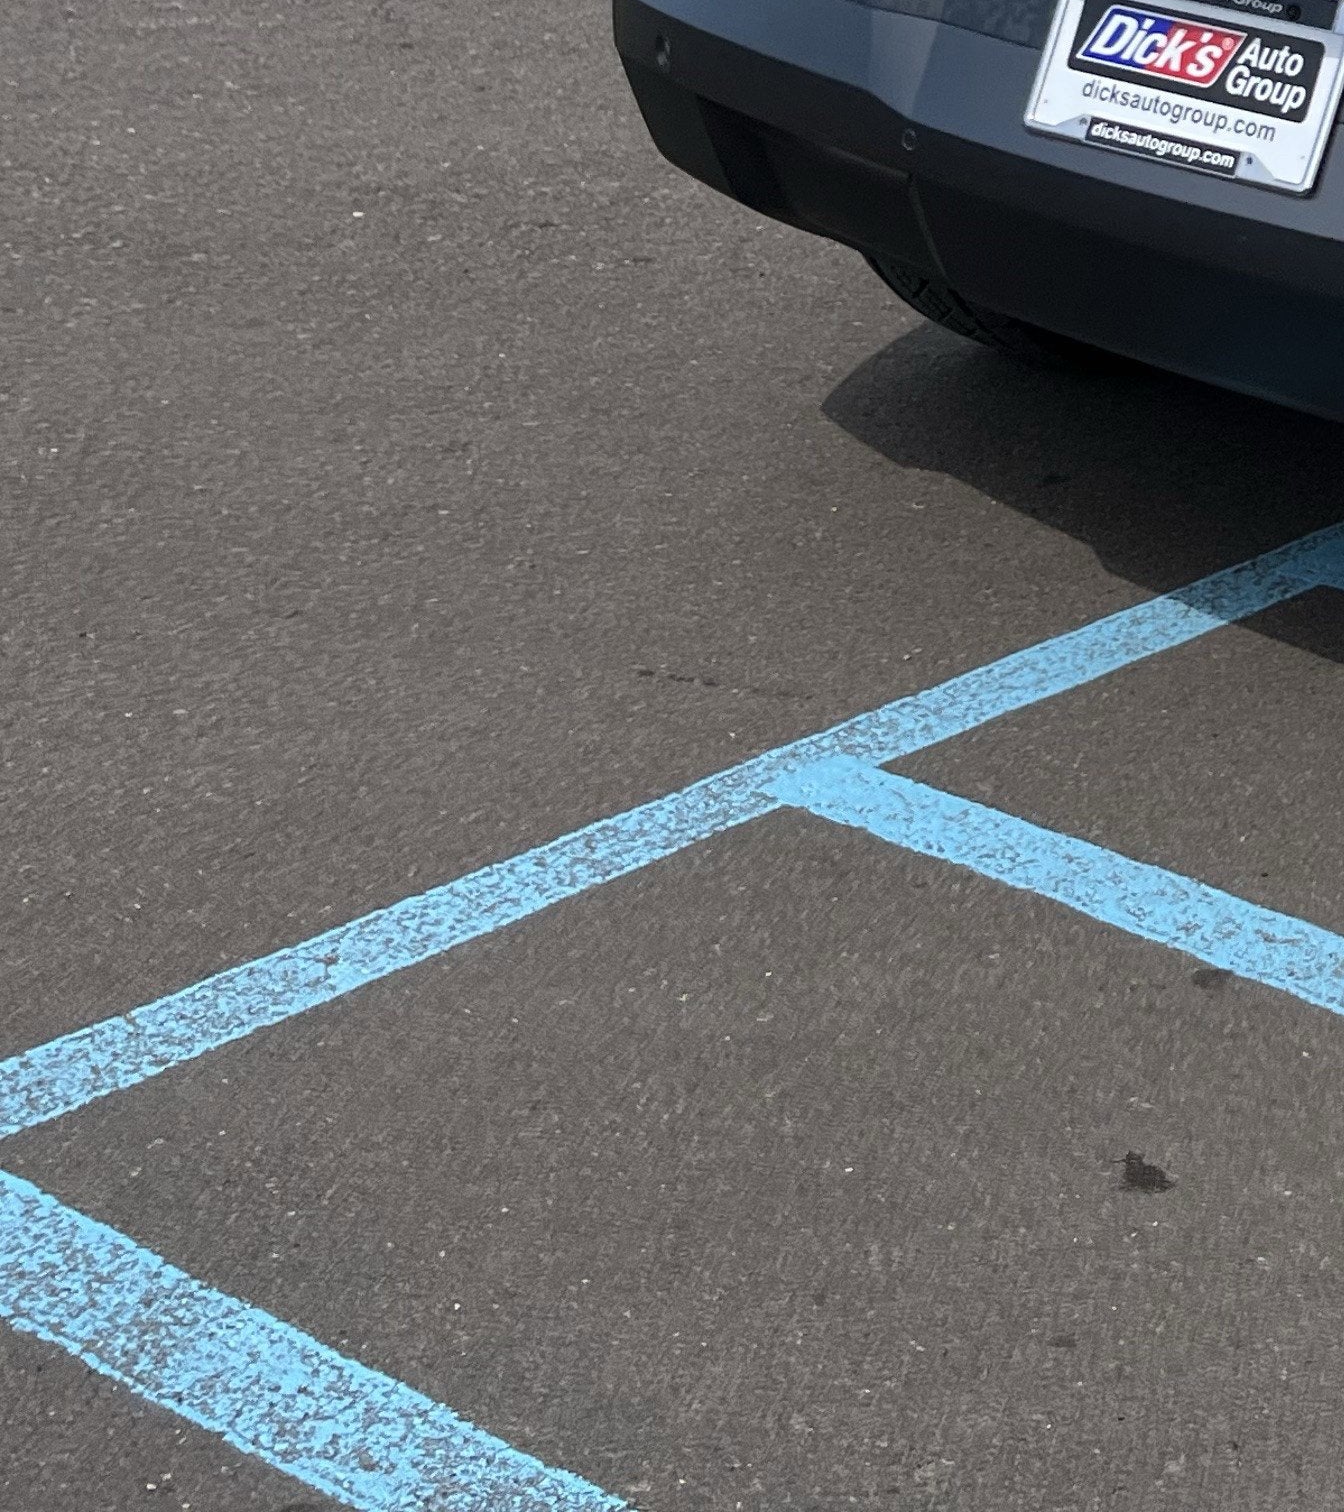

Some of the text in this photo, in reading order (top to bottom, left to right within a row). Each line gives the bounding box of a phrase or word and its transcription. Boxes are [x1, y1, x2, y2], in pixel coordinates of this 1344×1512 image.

[1092, 13, 1305, 79] Dick's Auto
[1082, 79, 1276, 143] dicksautogroup.com
[1224, 69, 1306, 115] Group
[1090, 120, 1235, 169] dicksautogroup.com
